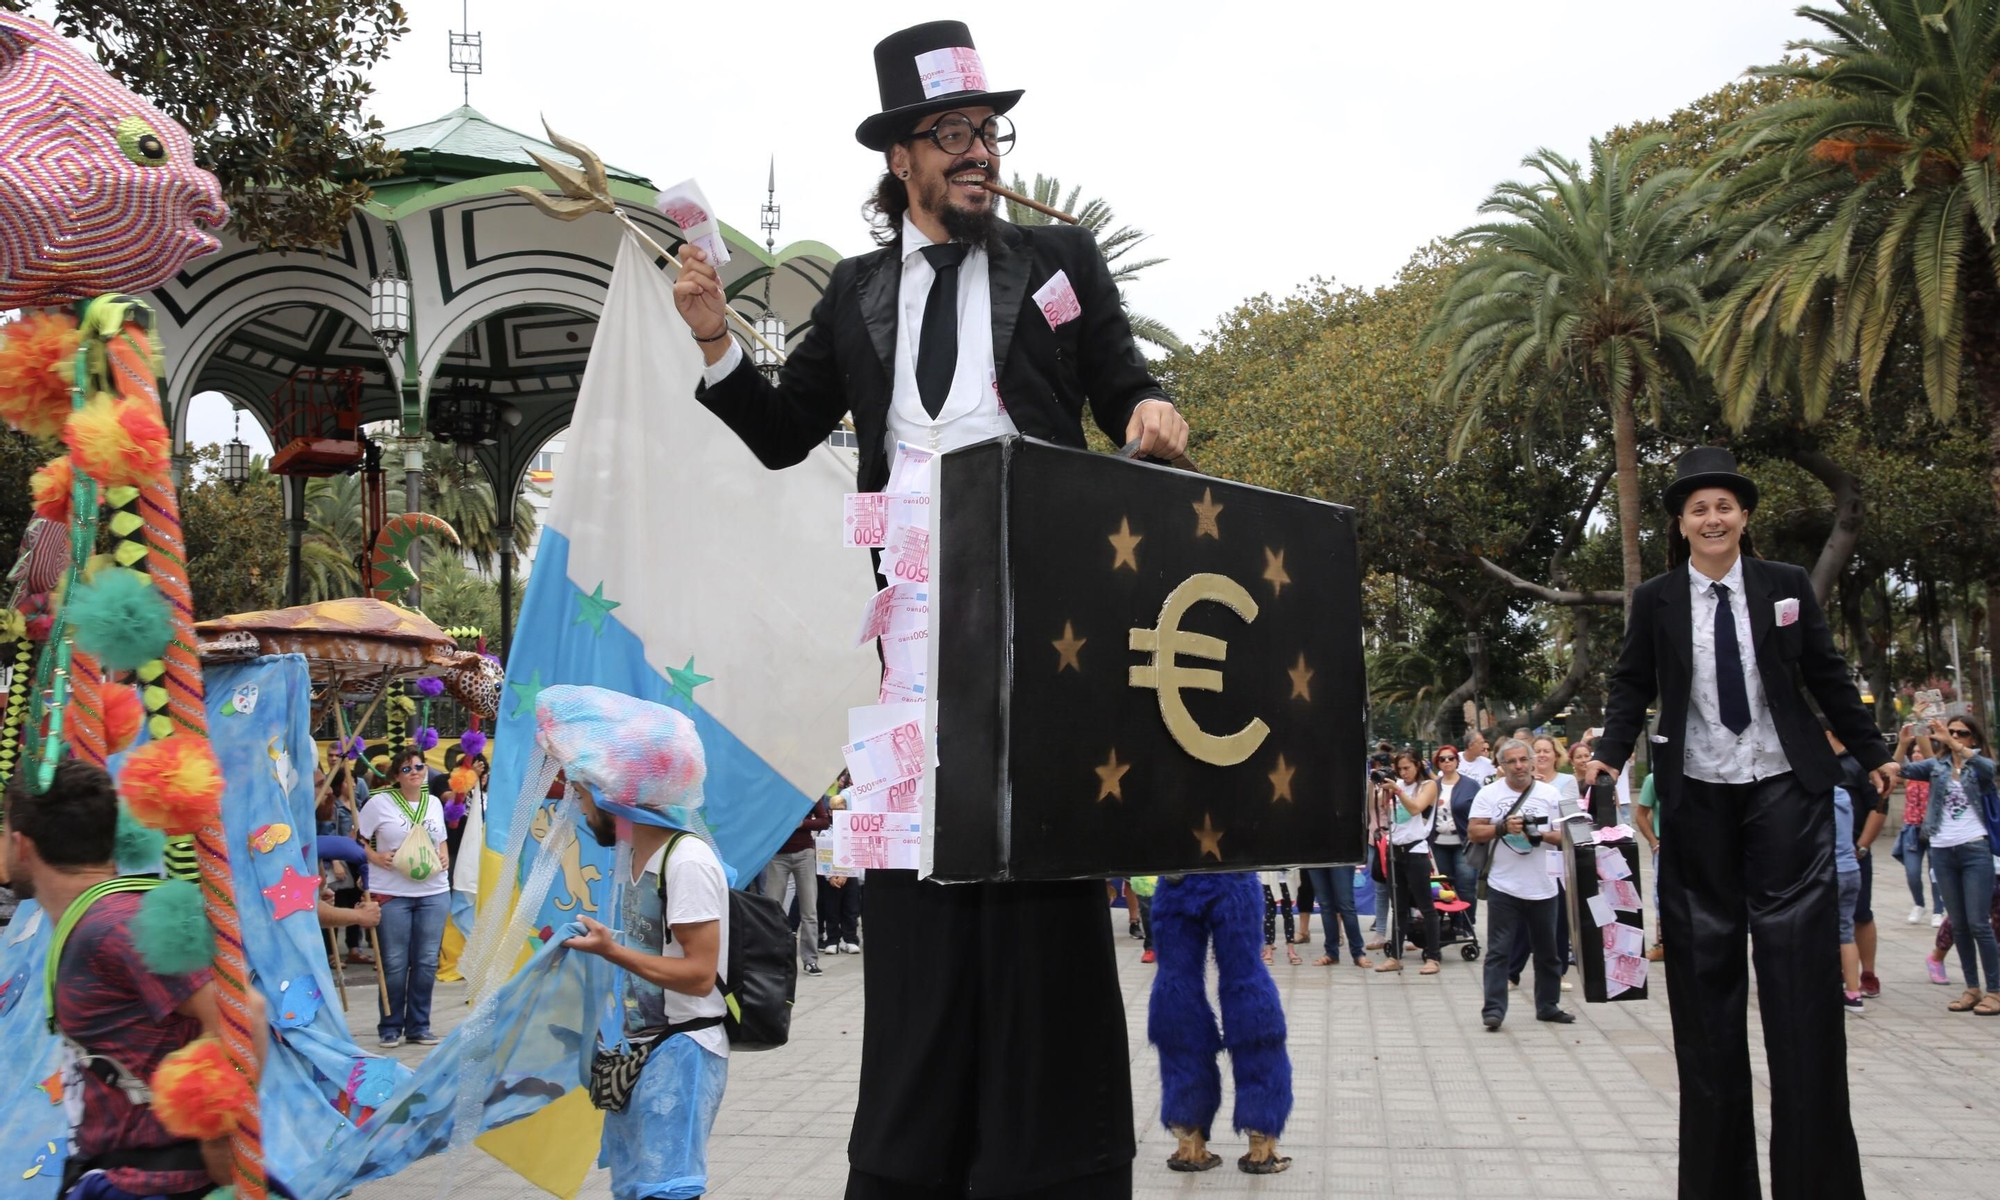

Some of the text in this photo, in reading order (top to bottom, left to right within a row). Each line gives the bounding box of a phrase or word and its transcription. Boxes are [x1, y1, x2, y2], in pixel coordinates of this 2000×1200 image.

[854, 528, 880, 544] 500
[894, 560, 928, 582] 500
[914, 630, 928, 640] 500
[856, 778, 886, 794] 500 EURO
[850, 816, 880, 832] 500
